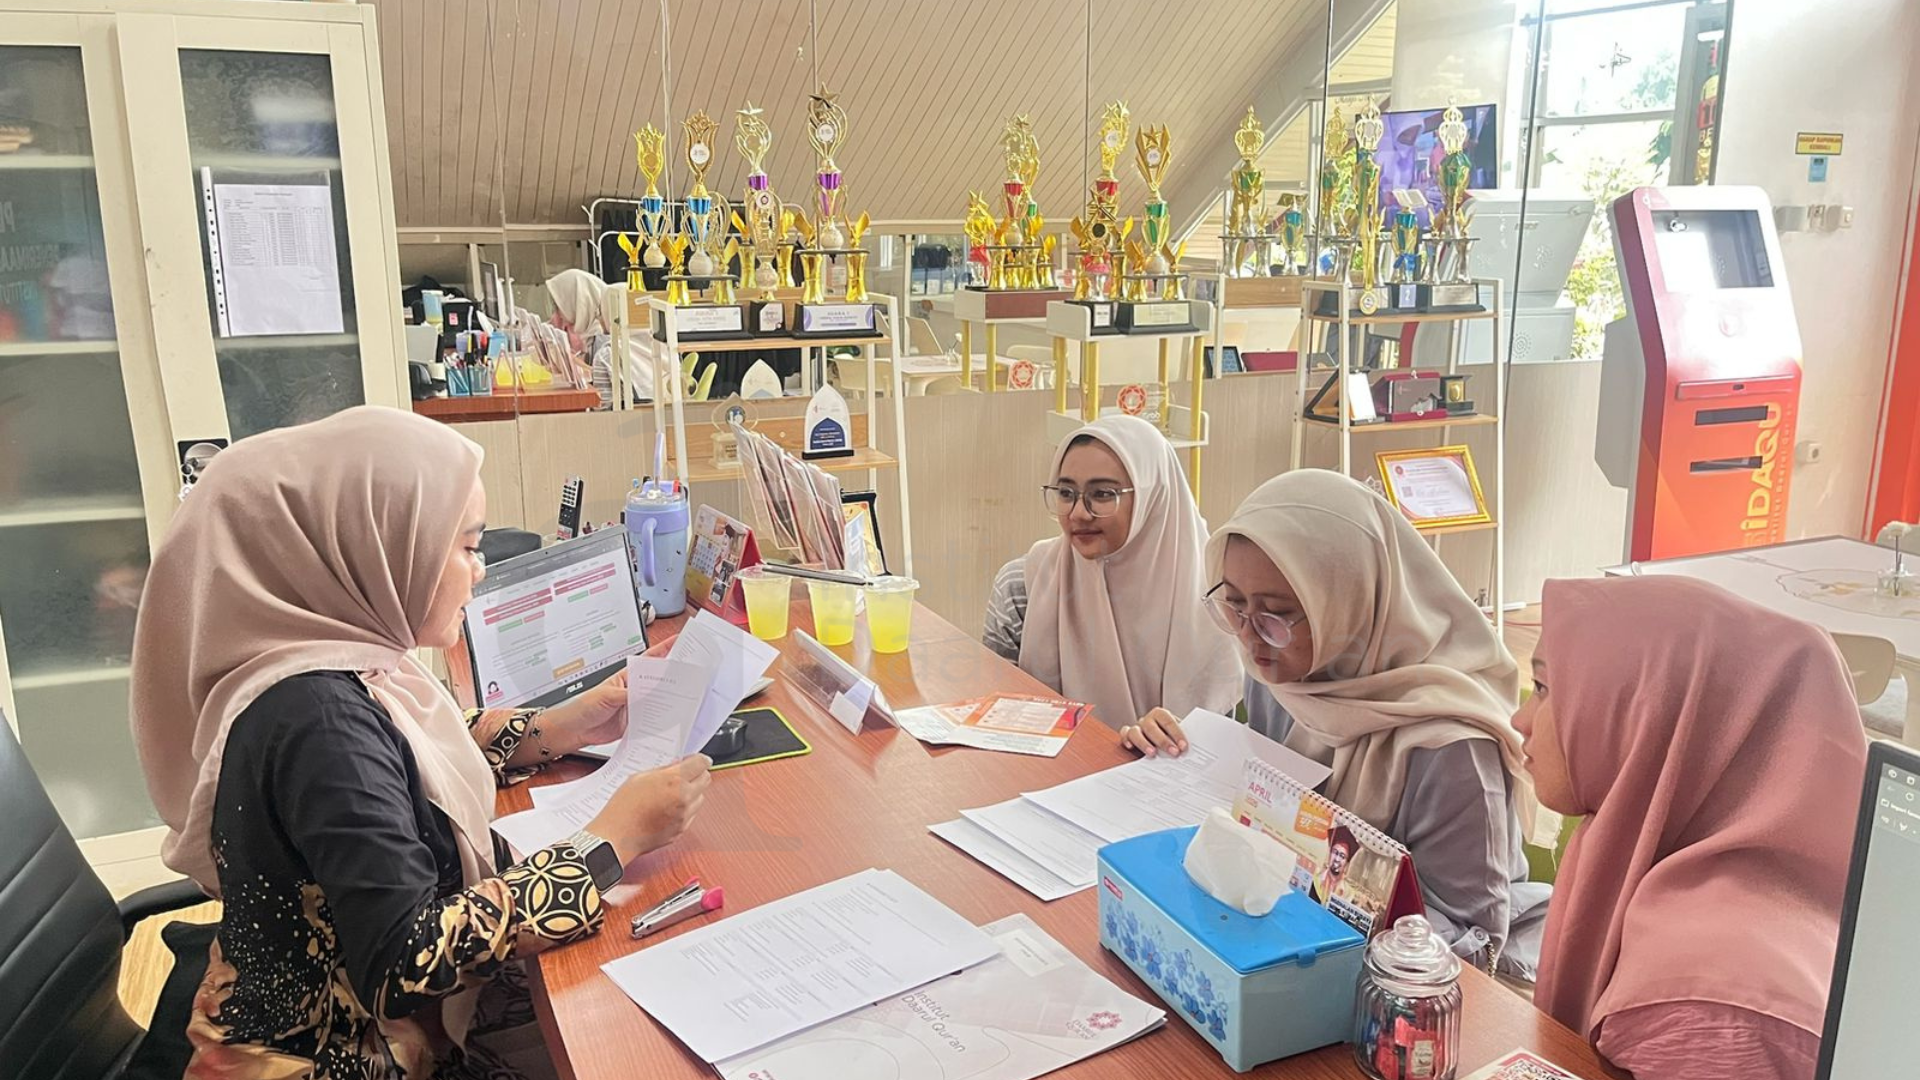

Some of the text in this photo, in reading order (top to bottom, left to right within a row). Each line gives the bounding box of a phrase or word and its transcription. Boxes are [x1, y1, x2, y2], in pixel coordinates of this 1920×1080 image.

[566, 681, 584, 694] ASUS
[1247, 781, 1273, 804] APRIL
[914, 990, 951, 1021] Institut
[901, 994, 966, 1053] Daarul Qur'an
